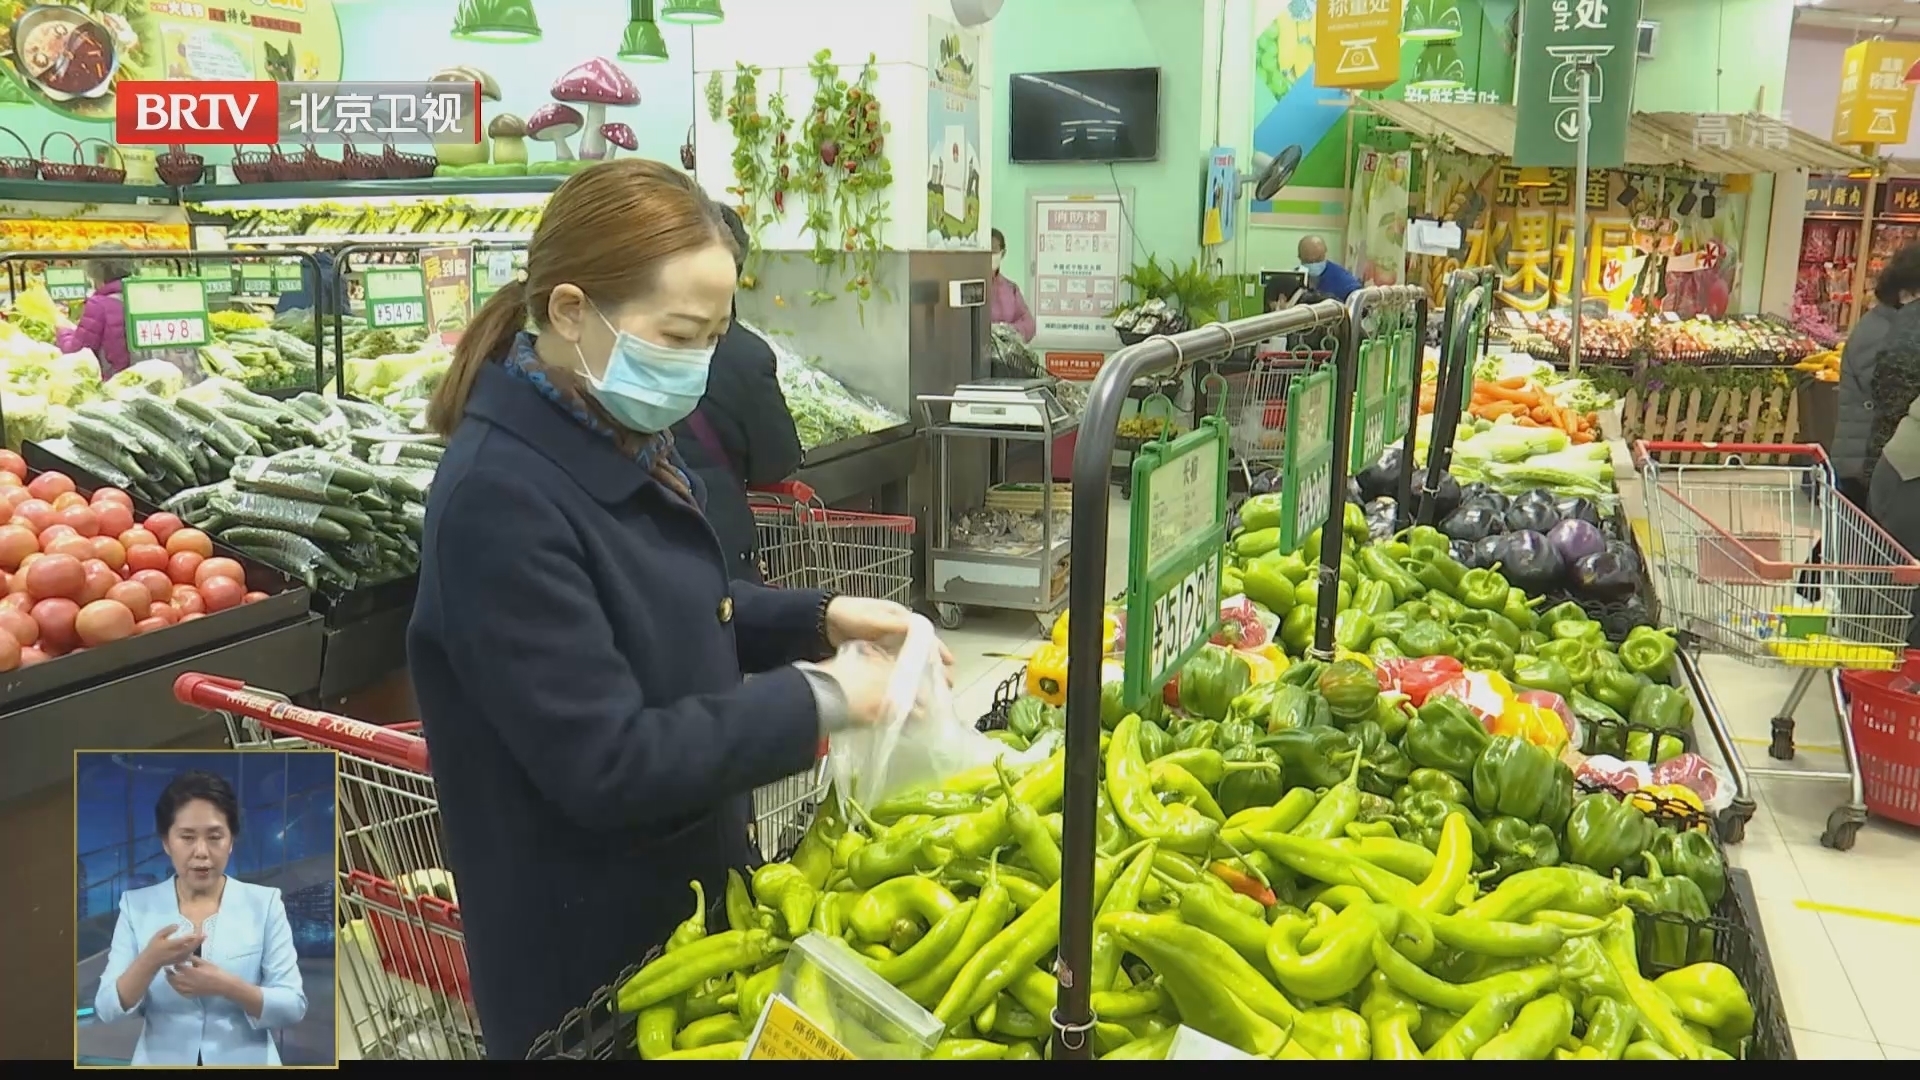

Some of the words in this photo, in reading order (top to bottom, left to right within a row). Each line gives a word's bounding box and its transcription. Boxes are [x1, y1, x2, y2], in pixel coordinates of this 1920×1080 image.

[1053, 210, 1101, 224] 消防栓
[793, 1019, 846, 1060] 降价商品
